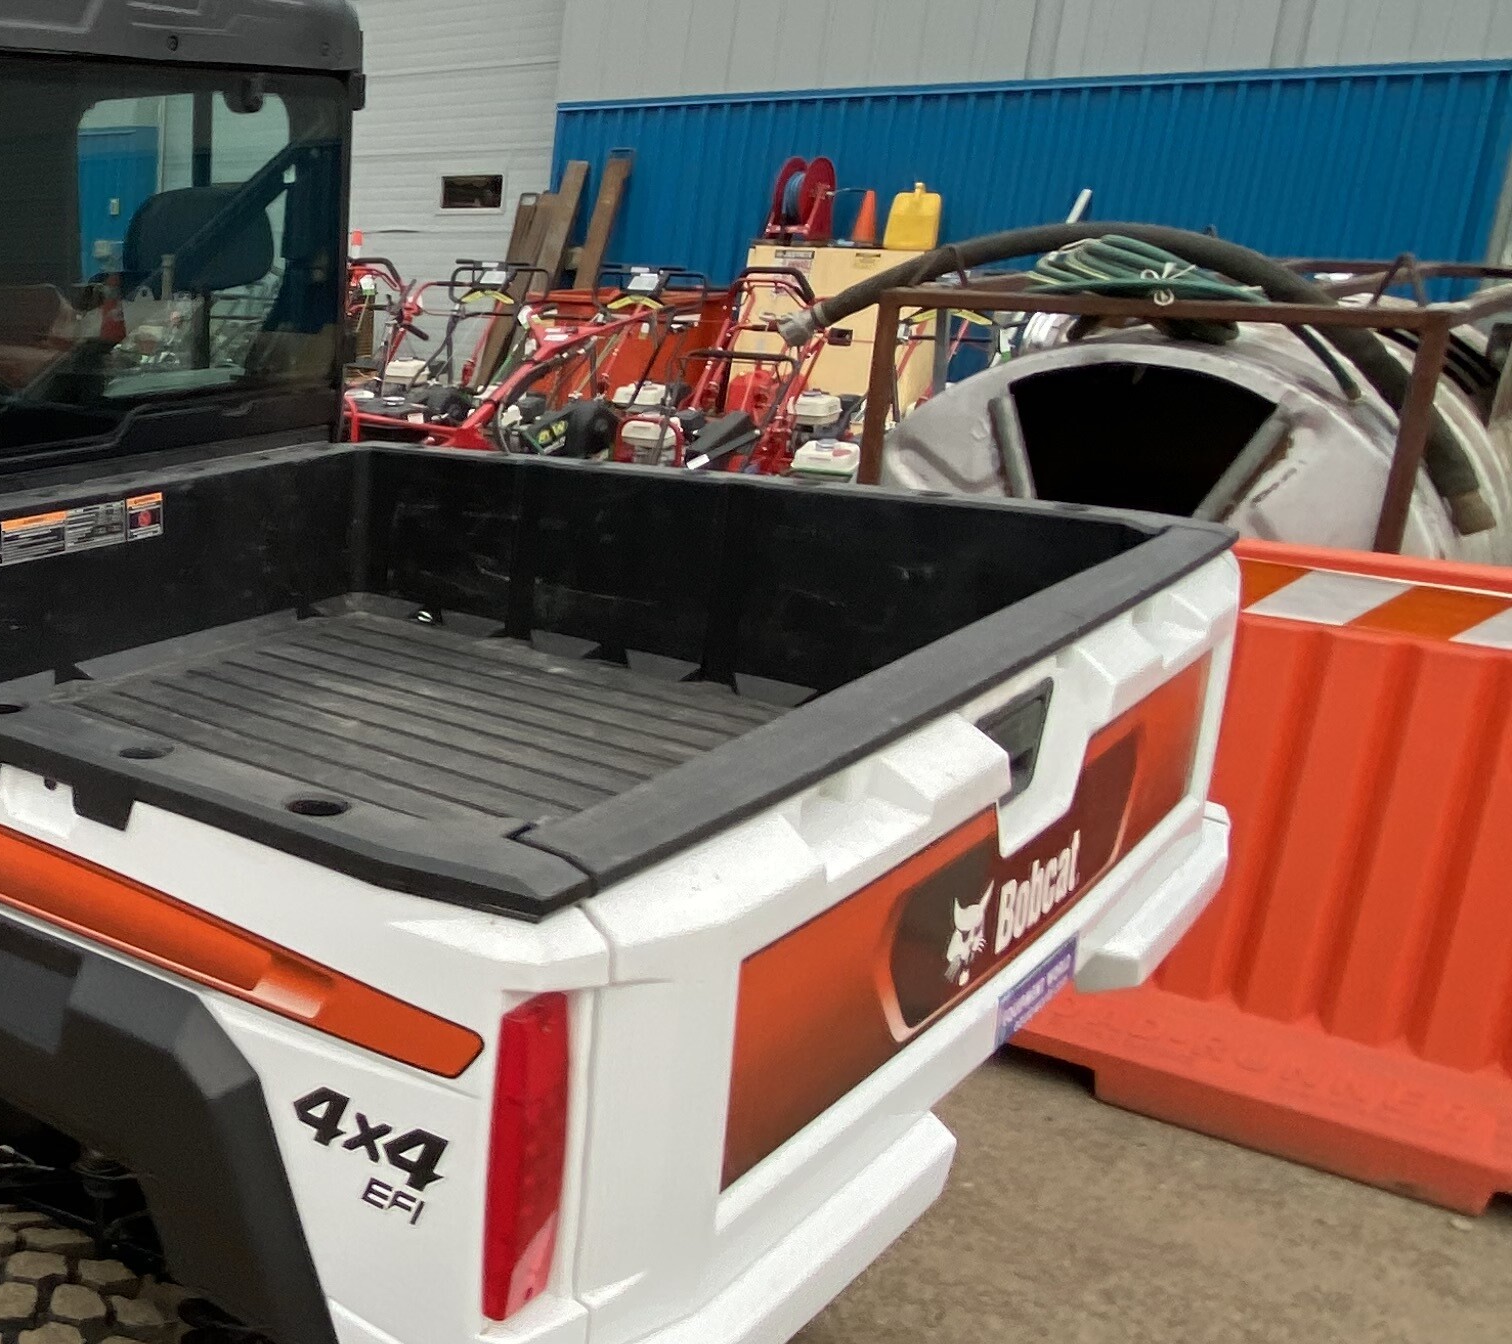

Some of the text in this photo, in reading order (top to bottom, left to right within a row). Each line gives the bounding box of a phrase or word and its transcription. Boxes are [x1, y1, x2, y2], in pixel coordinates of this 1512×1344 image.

[995, 829, 1080, 954] Bobcat
[293, 1086, 449, 1191] 4x4
[361, 1177, 426, 1225] EFI
